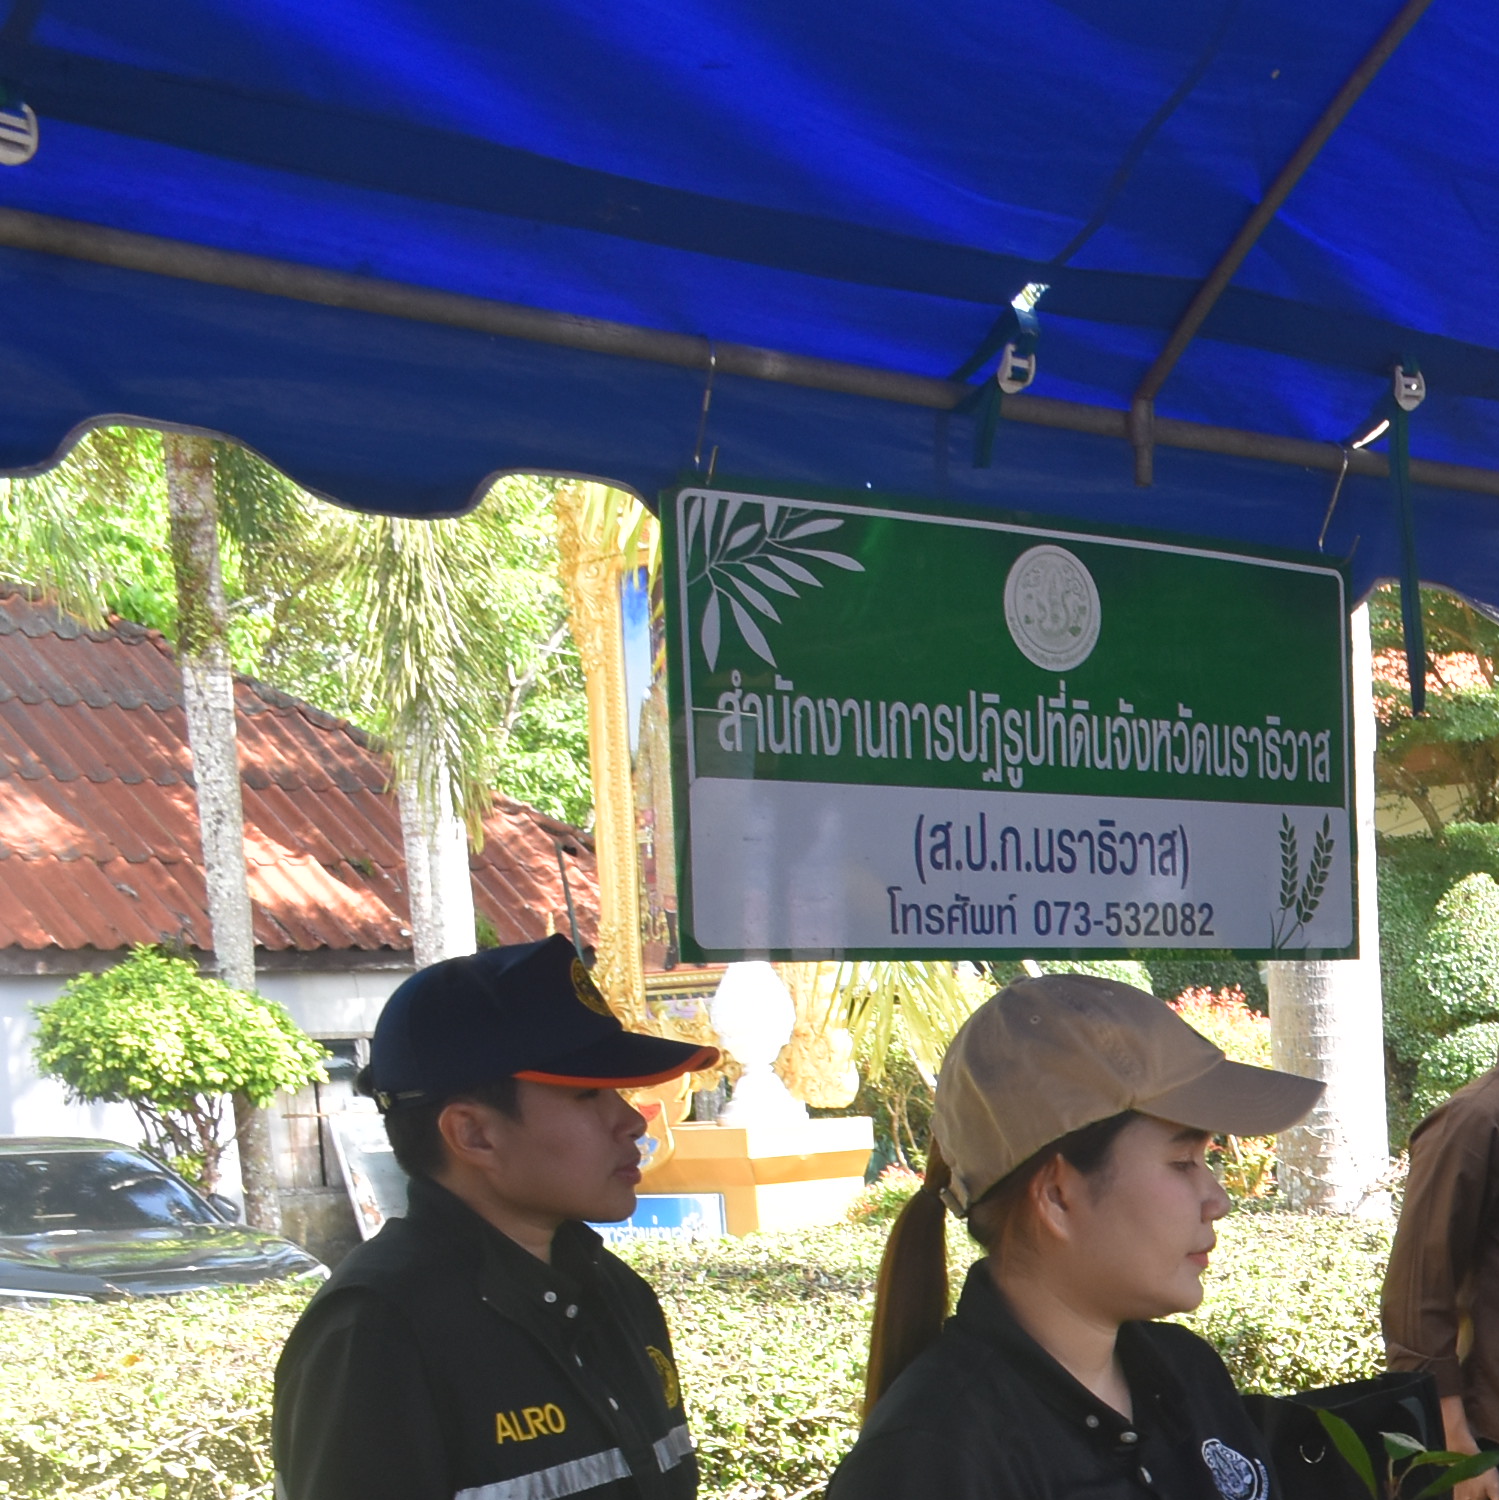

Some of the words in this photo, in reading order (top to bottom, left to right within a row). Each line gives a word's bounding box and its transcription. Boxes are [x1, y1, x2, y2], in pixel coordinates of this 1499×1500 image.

[914, 811, 1190, 889] (ส.ป.ก.นราธิวาส)
[887, 886, 1018, 937] โทรศัพท์
[1033, 900, 1215, 938] 073-532082
[495, 1403, 567, 1445] ALRO
